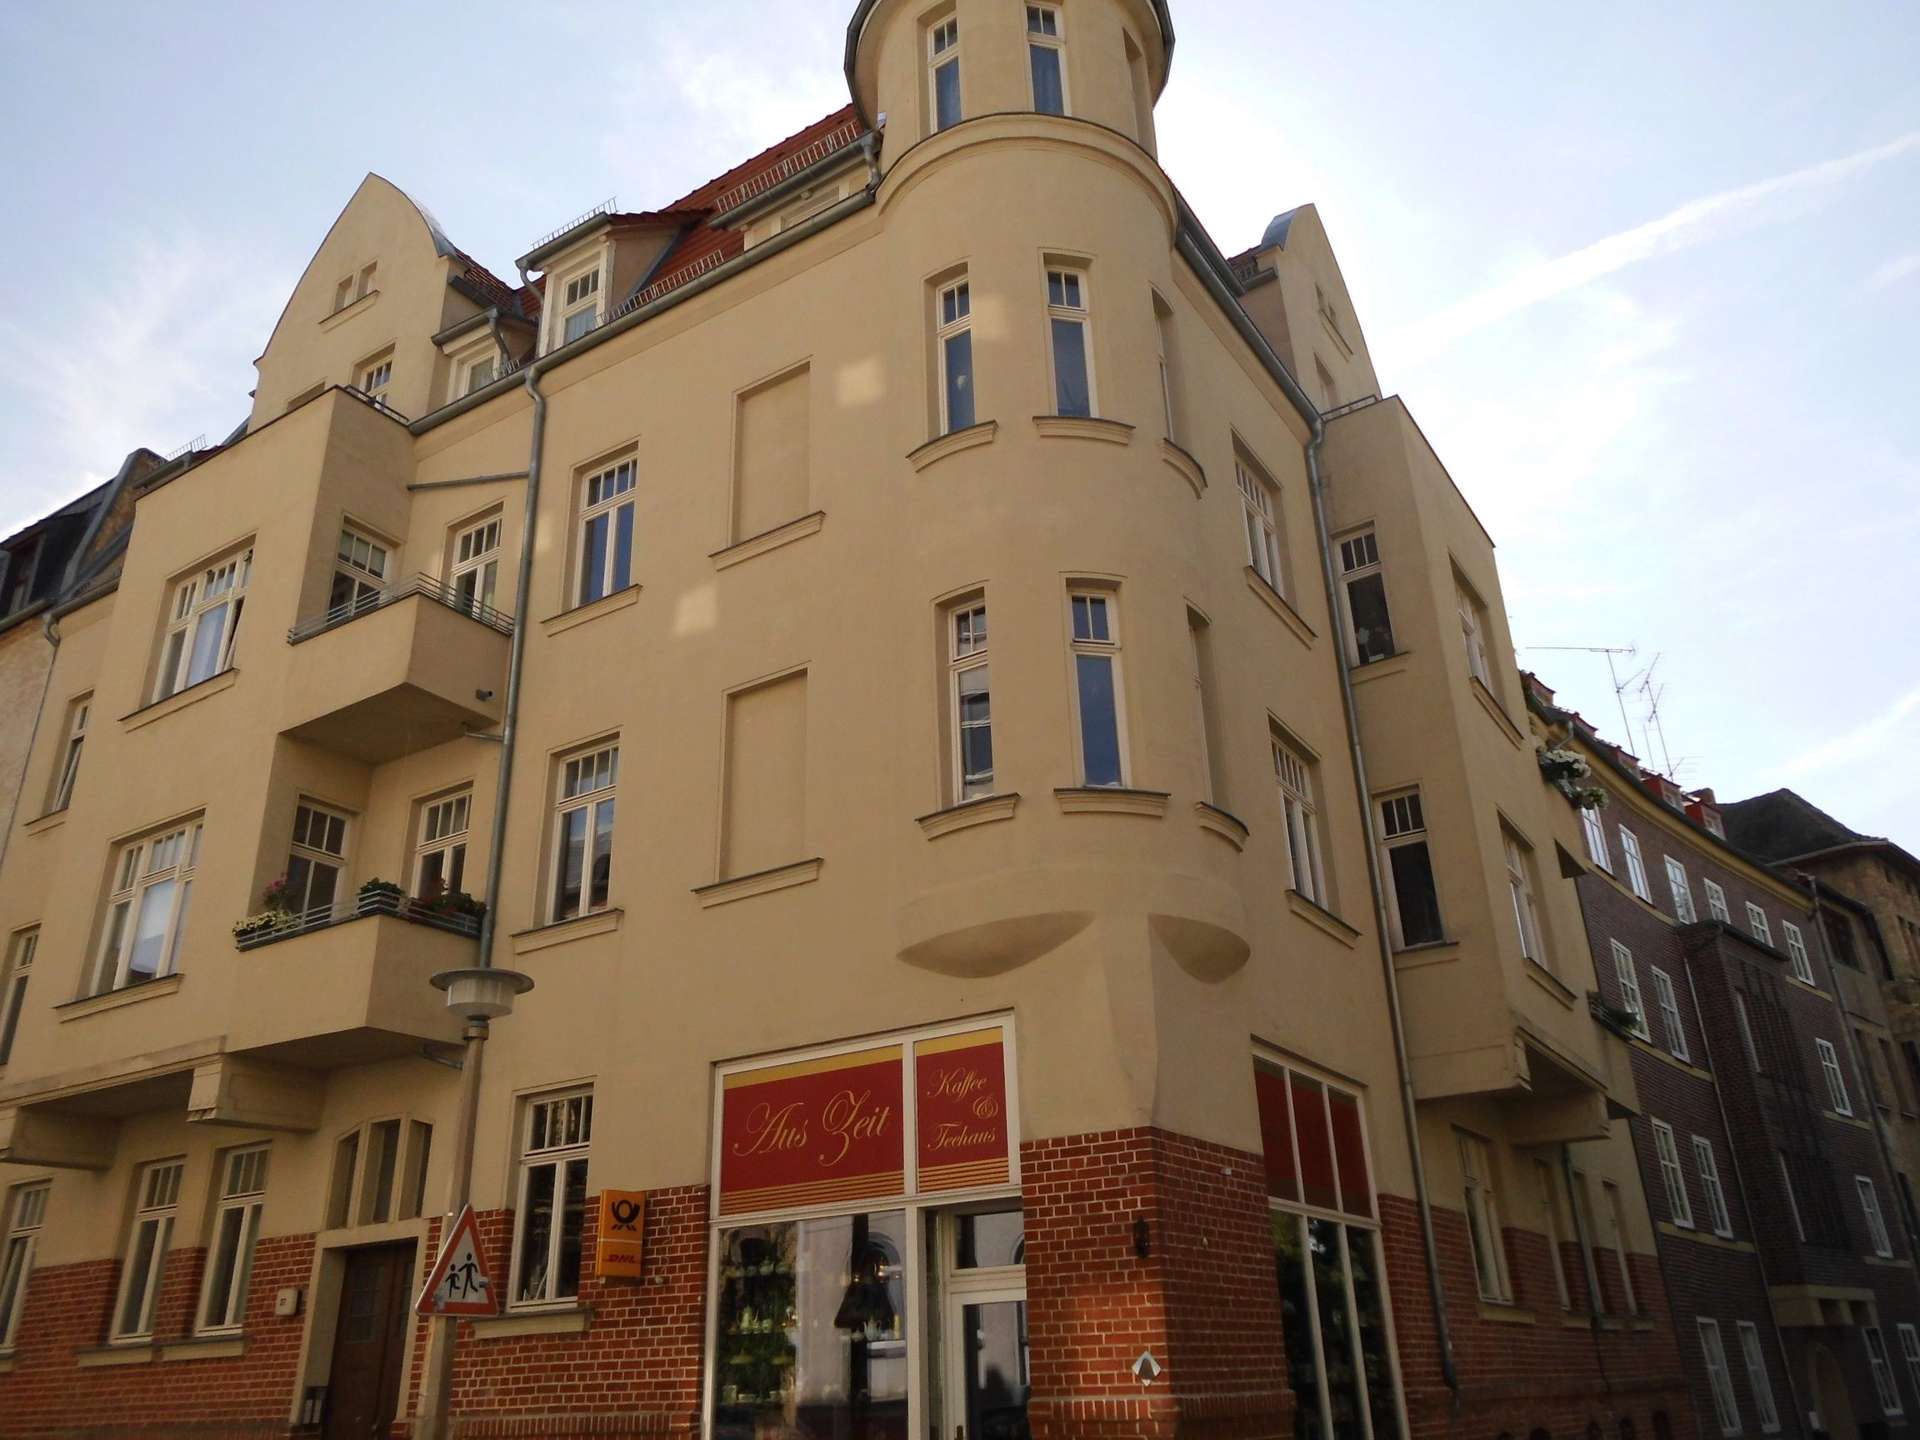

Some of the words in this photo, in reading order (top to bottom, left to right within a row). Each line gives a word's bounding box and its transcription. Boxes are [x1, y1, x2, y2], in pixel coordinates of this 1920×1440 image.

[927, 1067, 987, 1097] Kaffee
[972, 1096, 998, 1119] &
[732, 1102, 808, 1156] Aus
[819, 1090, 890, 1166] Zeit
[927, 1123, 996, 1150] Teehaus
[606, 1253, 638, 1264] DHL
